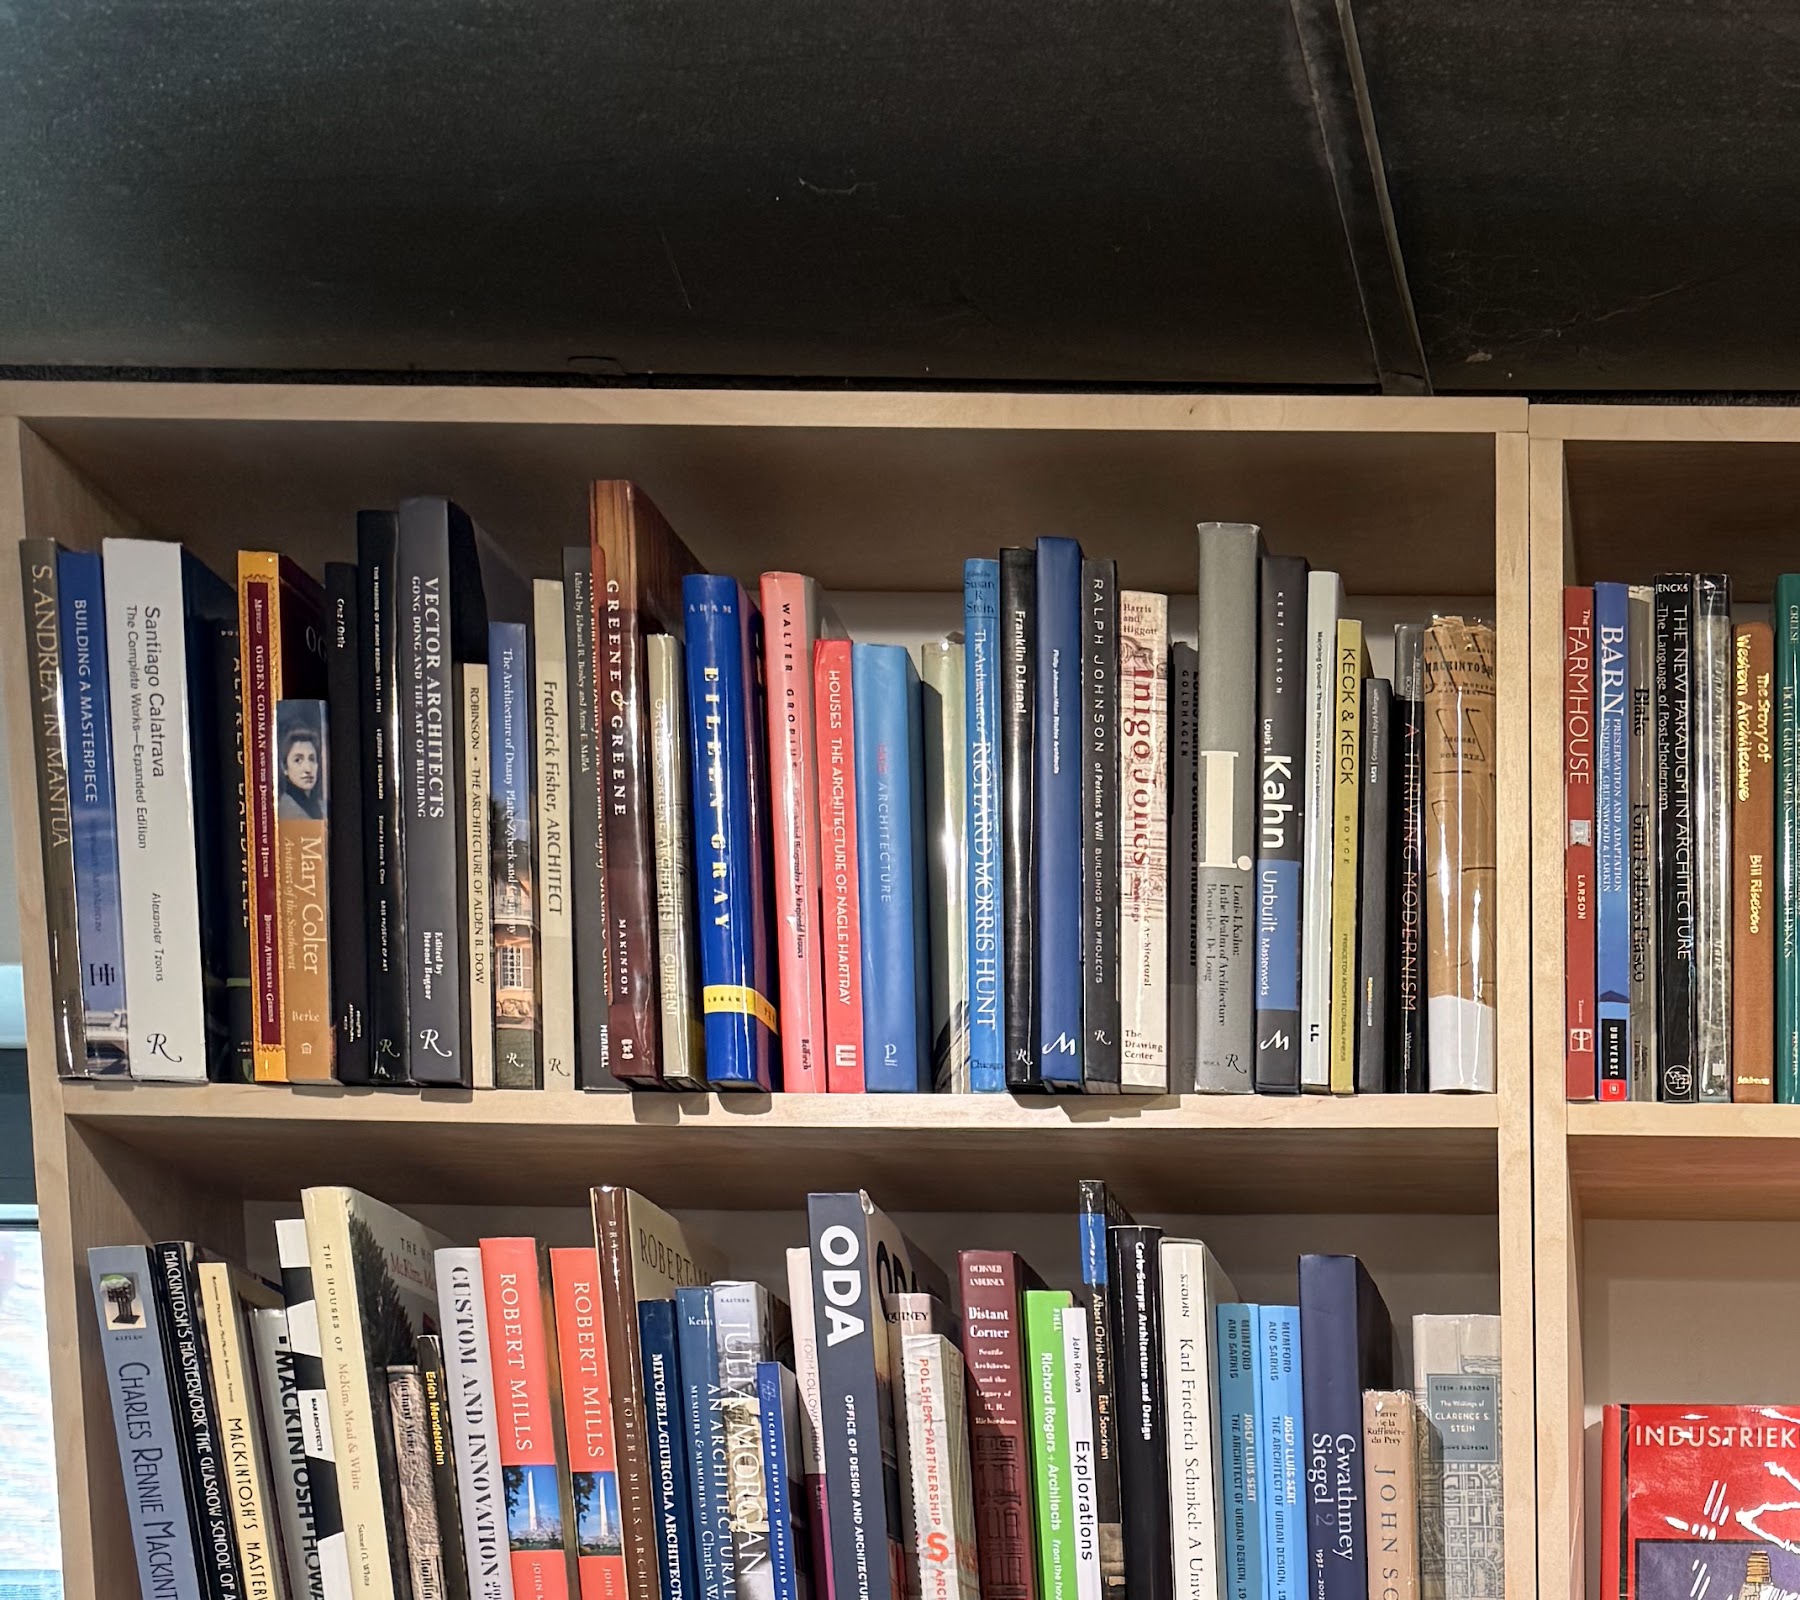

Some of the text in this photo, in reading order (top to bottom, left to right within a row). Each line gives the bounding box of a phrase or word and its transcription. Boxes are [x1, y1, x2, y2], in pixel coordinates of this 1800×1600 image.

[143, 606, 165, 778] Santiago Calatrava
[423, 576, 445, 819] VECTOR ARCHITECTS
[1568, 625, 1591, 785] FARMHOUSE
[1600, 624, 1625, 718] BARN
[1261, 754, 1292, 850] Kahn
[1261, 870, 1279, 932] Unbuilt
[1576, 875, 1587, 921] LARSON
[1609, 1025, 1619, 1075] UNIVERSE
[819, 1225, 864, 1346] ODA
[117, 1361, 152, 1442] CHARLES
[500, 1273, 533, 1451] ROBERT MILLS
[574, 1282, 605, 1457] ROBERT MILLS
[131, 1448, 162, 1514] RENNIE
[1074, 1441, 1094, 1562] Explorations
[1308, 1433, 1331, 1505] Siegel
[1334, 1433, 1355, 1561] Gwathmey
